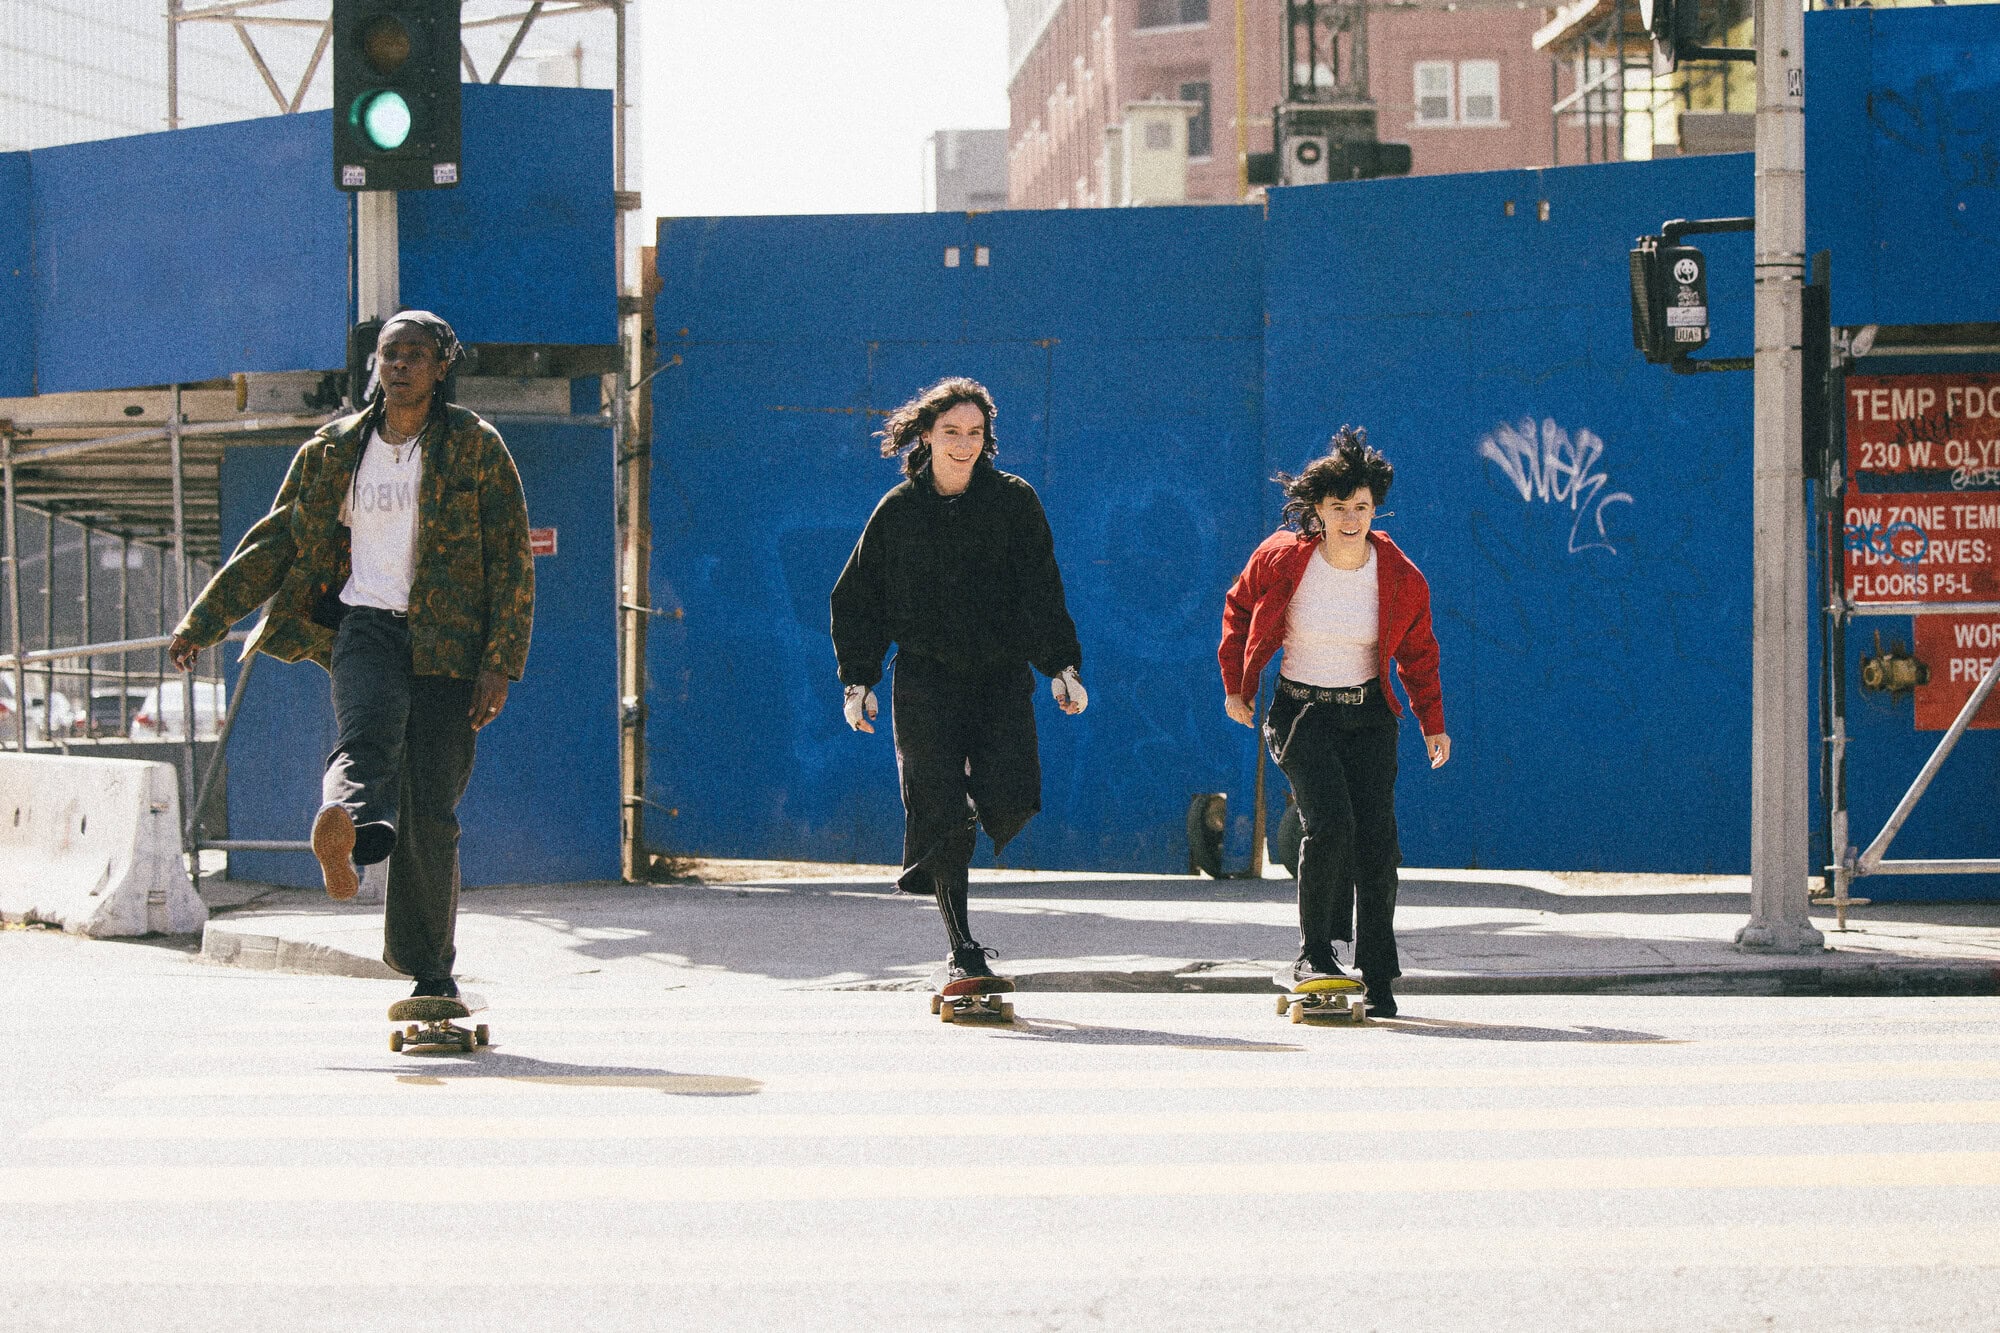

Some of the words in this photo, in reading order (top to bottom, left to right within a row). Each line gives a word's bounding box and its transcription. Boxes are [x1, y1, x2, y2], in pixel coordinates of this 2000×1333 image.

[1851, 387, 1936, 421] TEMP
[1860, 441, 1901, 468] 230
[1908, 441, 1937, 468] W.
[1944, 440, 2000, 467] OLY
[1845, 507, 1882, 532] OW
[1888, 506, 1946, 530] ZONE
[1951, 505, 2000, 529] TEM
[1901, 539, 1992, 564] SERVES:
[1853, 573, 1928, 596] FLOORS
[1934, 573, 1972, 594] P5-L
[1950, 657, 2000, 683] PRE
